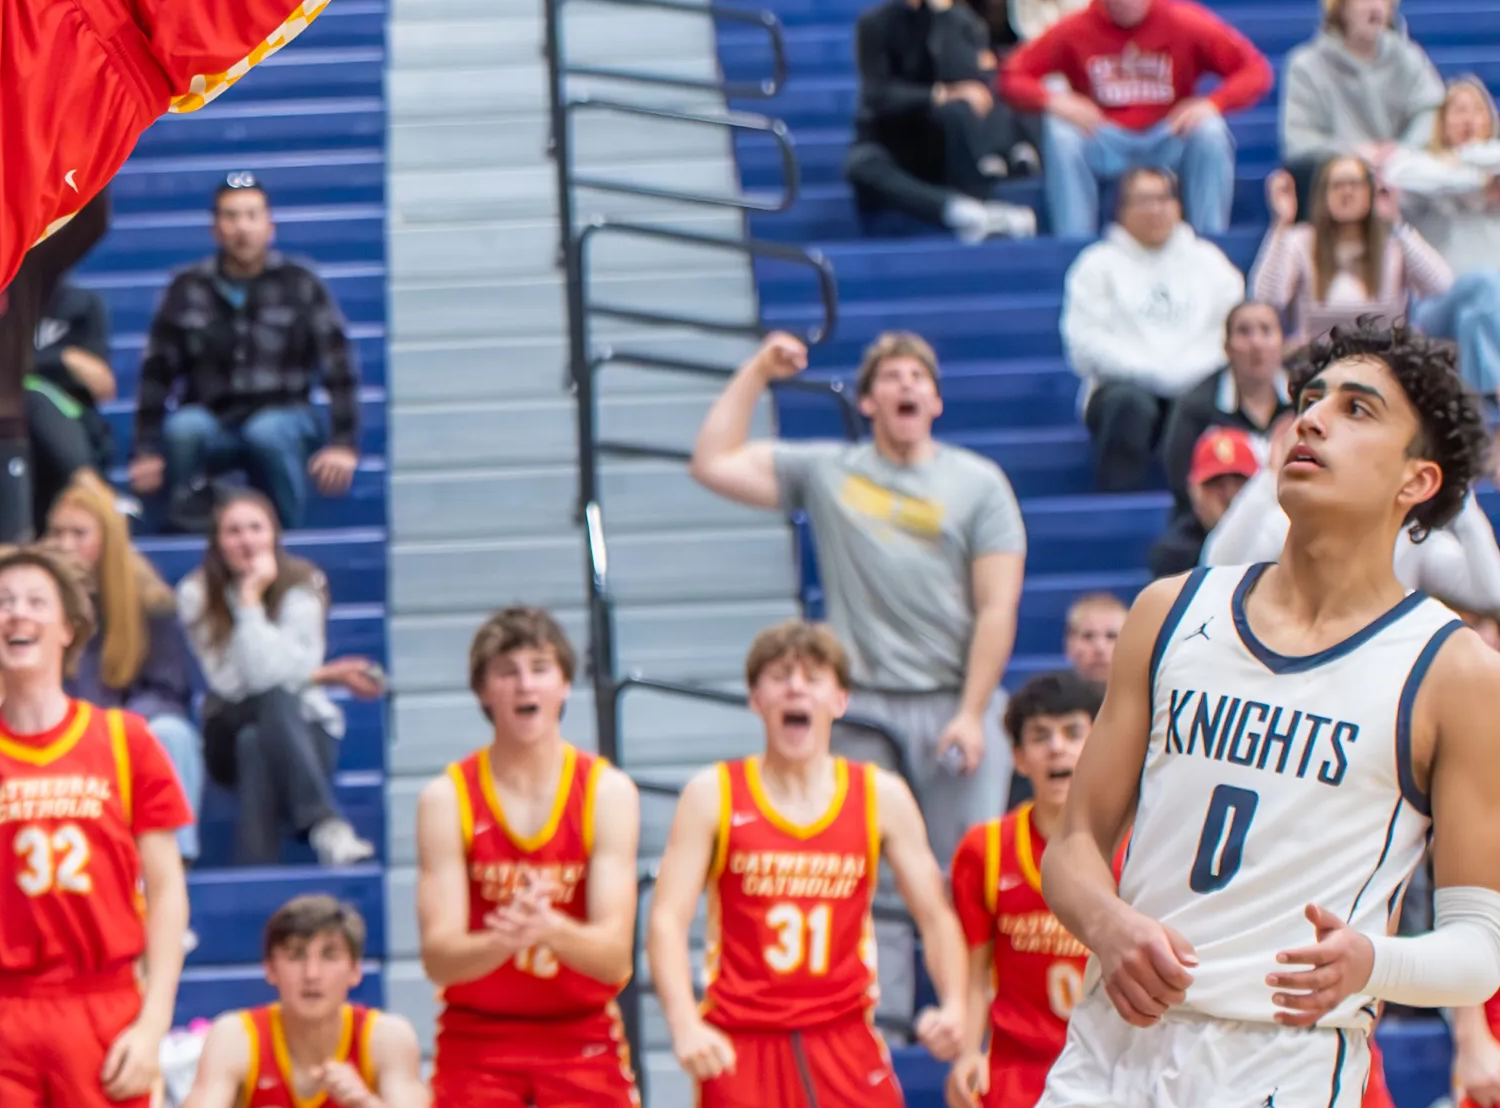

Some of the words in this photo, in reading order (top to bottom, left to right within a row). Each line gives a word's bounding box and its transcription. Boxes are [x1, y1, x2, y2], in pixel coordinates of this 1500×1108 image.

[1165, 689, 1360, 786] KNIGHTS
[12, 823, 93, 897] 32
[729, 848, 867, 879] CATHEDRAL
[1189, 784, 1259, 894] 0
[763, 901, 833, 977] 31
